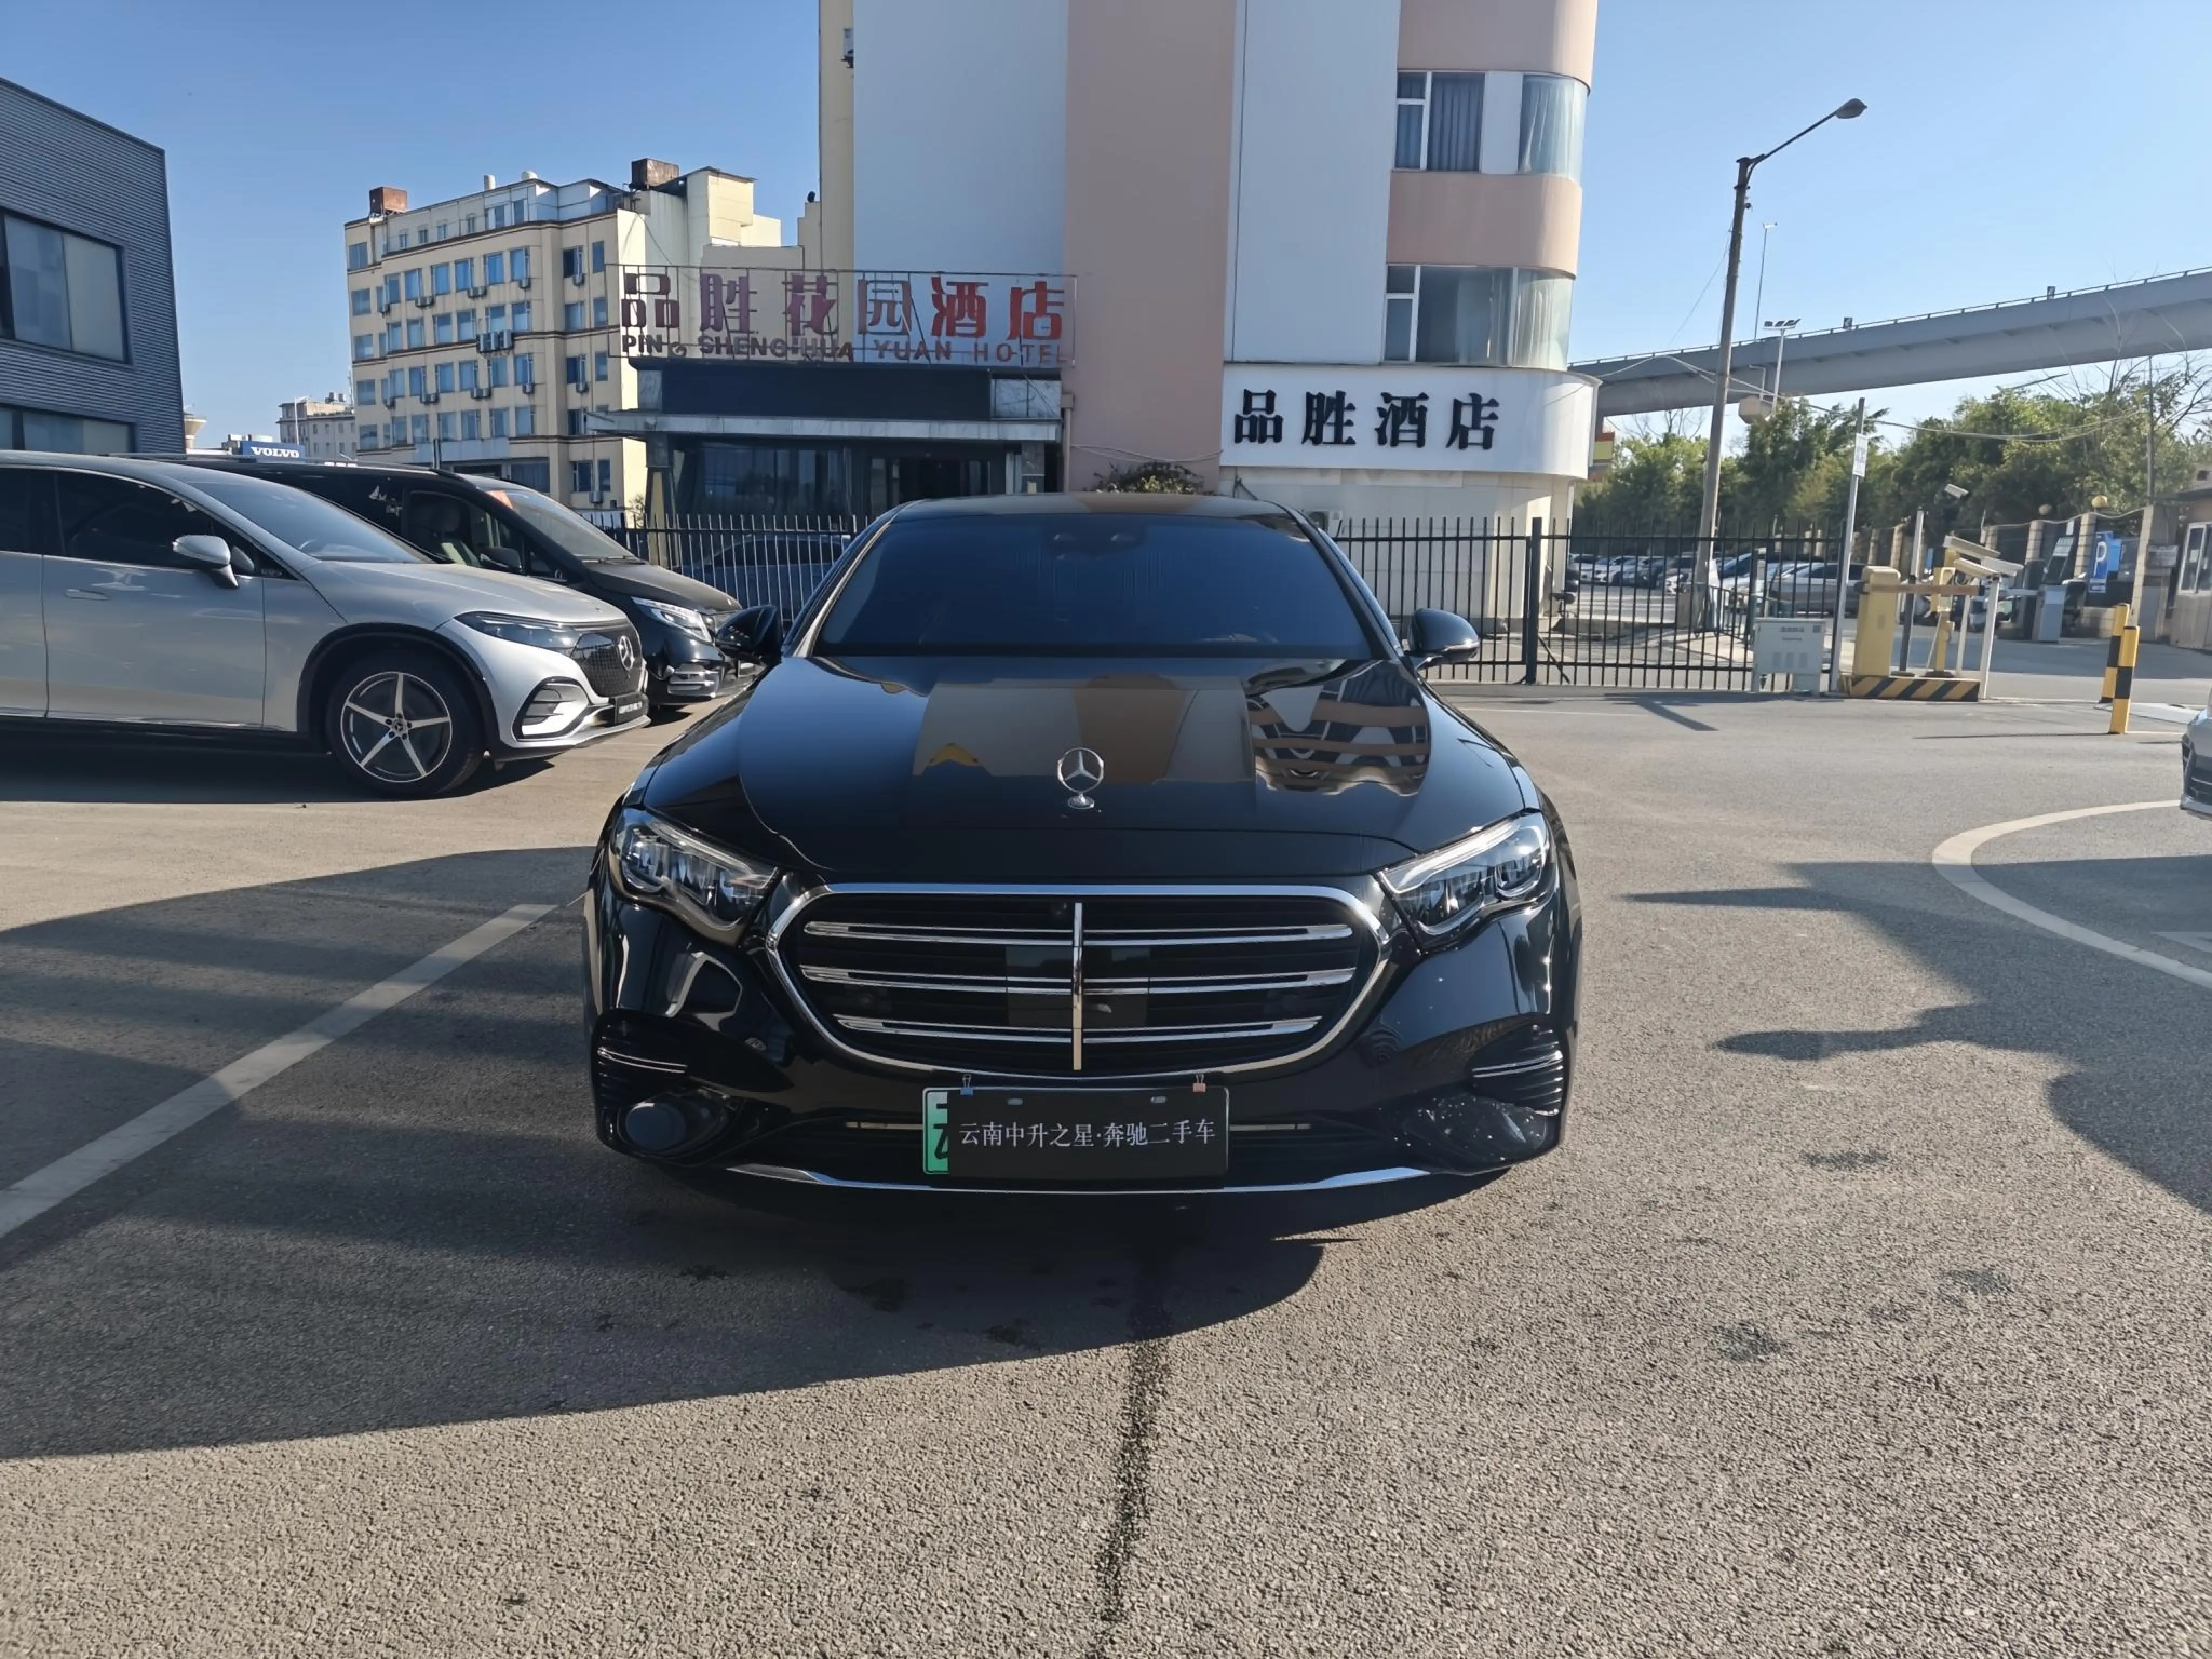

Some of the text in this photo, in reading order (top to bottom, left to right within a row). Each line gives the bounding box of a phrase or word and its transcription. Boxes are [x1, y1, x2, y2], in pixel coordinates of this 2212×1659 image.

[621, 273, 1064, 341] 品胜花园酒店
[874, 339, 952, 361] YUAN
[974, 342, 1067, 364] HOTEL
[1233, 388, 1500, 450] 品胜酒店
[251, 447, 300, 458] VOLVO
[959, 1118, 1217, 1148] 云南中升之星·奔驰二手车
